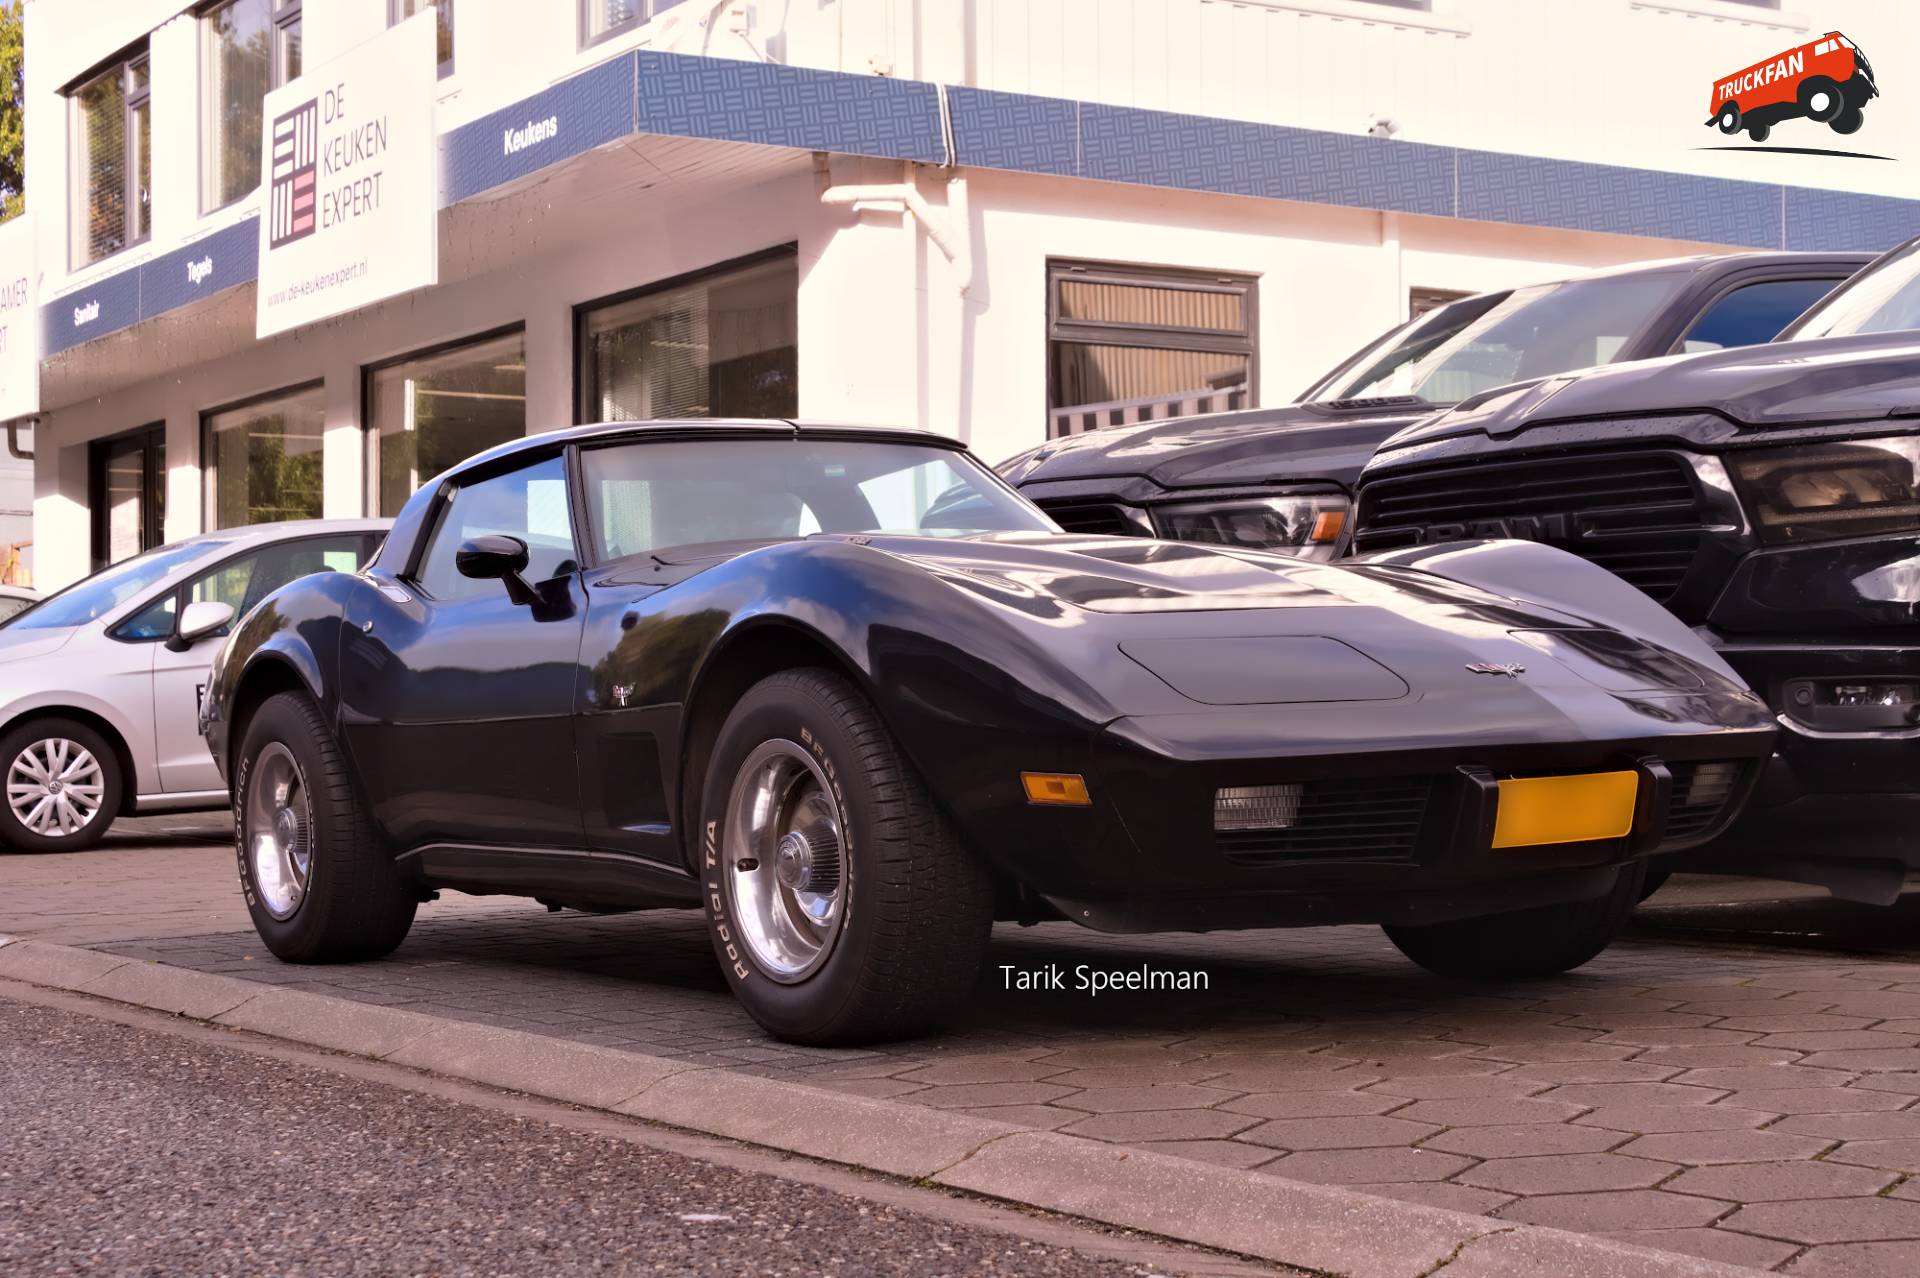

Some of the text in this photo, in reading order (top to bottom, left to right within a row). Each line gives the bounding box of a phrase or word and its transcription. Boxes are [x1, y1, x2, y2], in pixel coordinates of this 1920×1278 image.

[324, 83, 345, 125] DE
[323, 115, 388, 177] KEUKEN
[504, 115, 558, 156] Keukens
[322, 171, 383, 230] EXPERT
[187, 255, 213, 285] Tegels
[267, 257, 369, 308] www.de-keukenexpert.nl
[1424, 511, 1570, 546] RAM
[705, 820, 750, 980] Radial T/A
